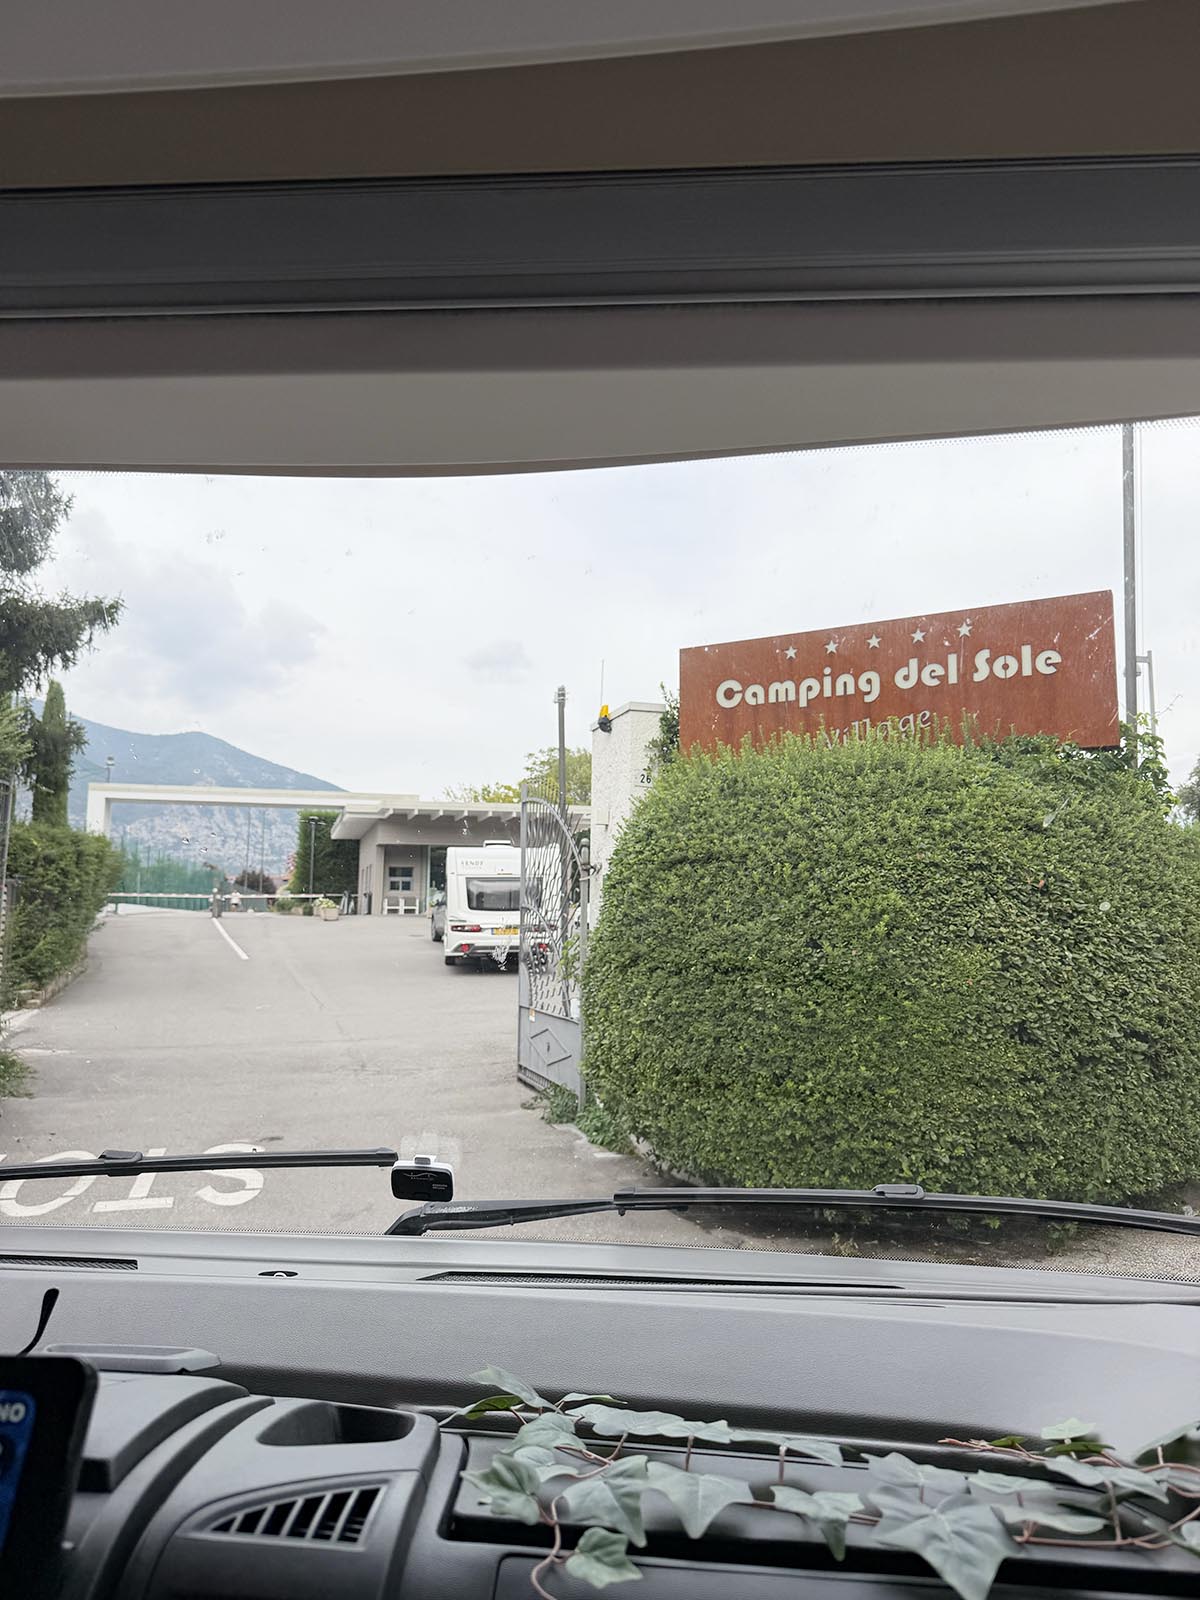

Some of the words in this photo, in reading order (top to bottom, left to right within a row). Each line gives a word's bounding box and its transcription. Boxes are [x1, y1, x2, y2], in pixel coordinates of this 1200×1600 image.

[715, 666, 881, 709] Camping
[894, 652, 959, 690] del
[972, 644, 1063, 683] Sole
[640, 773, 652, 784] 26
